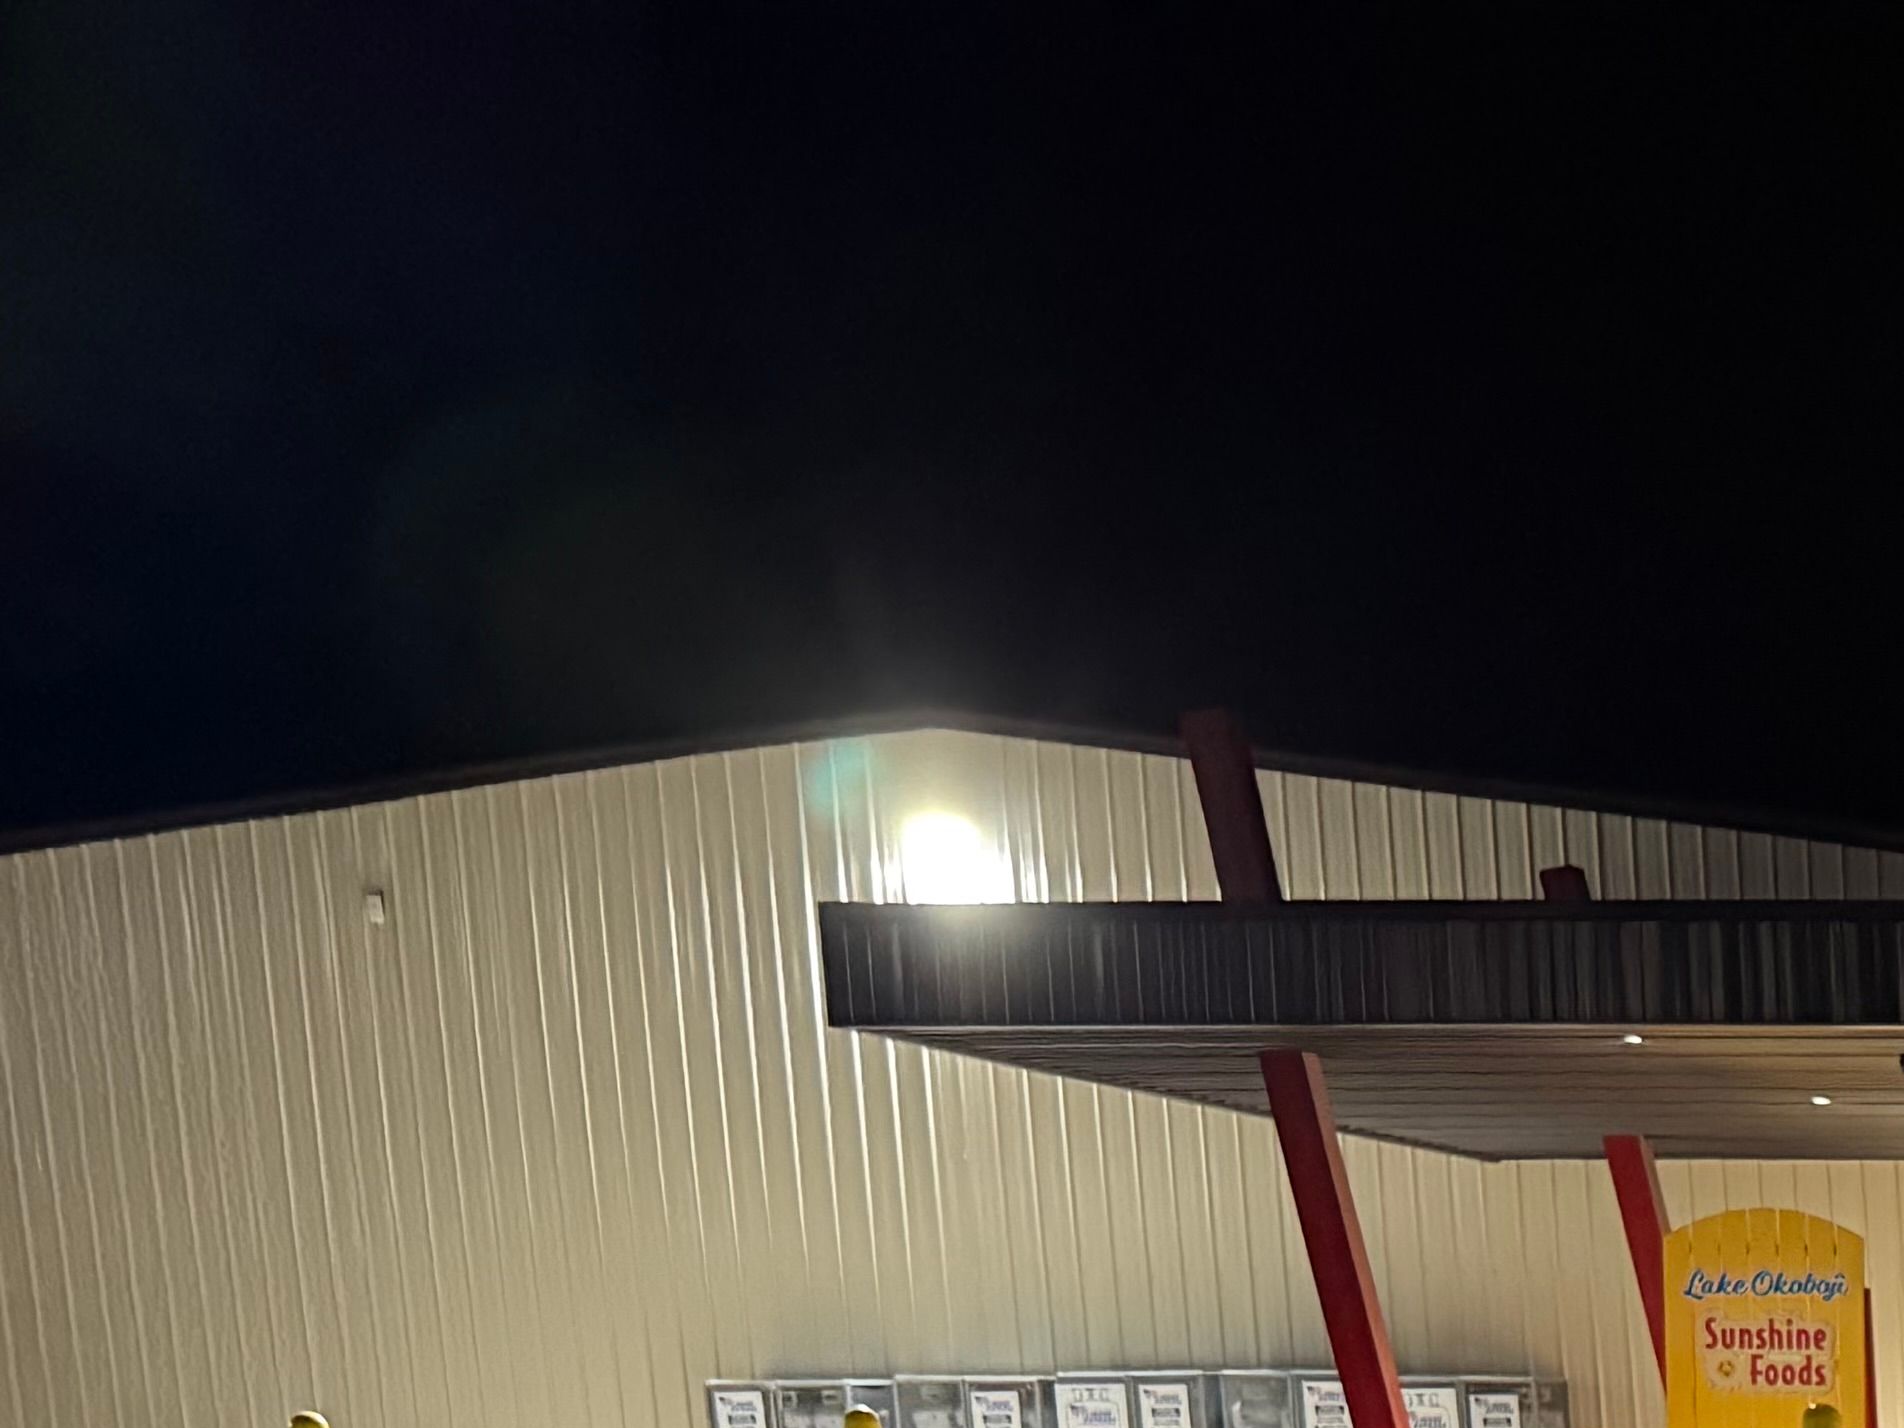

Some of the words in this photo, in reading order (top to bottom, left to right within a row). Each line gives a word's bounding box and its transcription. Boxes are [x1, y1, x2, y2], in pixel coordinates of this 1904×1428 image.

[1683, 1269, 1748, 1300] Lake
[1751, 1269, 1847, 1301] Okoboji
[1704, 1316, 1827, 1351] Sunshine
[1749, 1354, 1827, 1387] Foods
